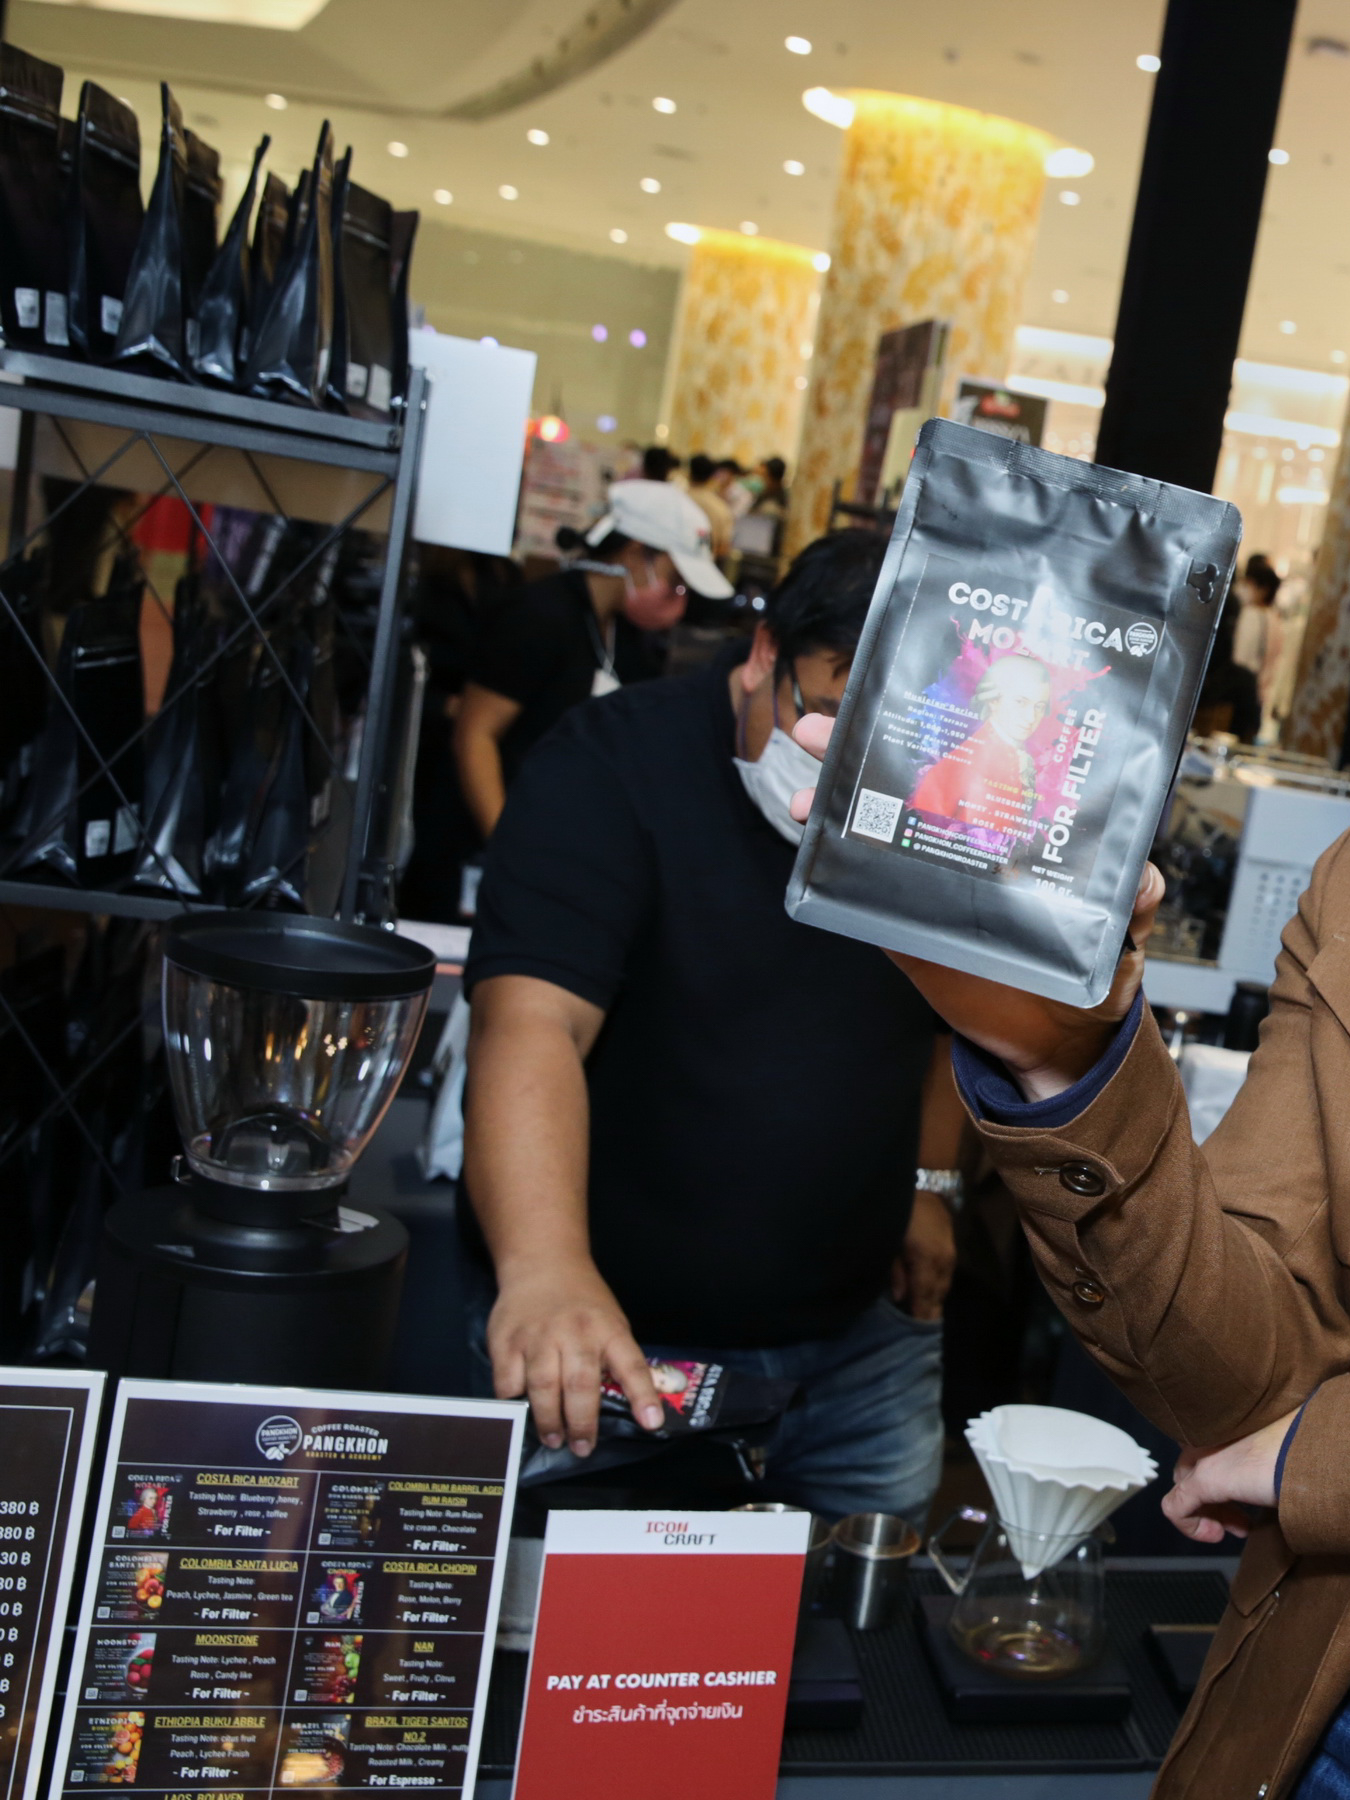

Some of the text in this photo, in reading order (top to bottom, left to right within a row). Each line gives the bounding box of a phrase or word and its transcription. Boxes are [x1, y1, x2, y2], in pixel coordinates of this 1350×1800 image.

[949, 582, 1048, 630] COST
[968, 618, 1090, 672] MOZRT
[903, 690, 980, 720] Musician Series
[882, 734, 905, 746] Plant
[1053, 708, 1078, 763] COFFEE
[1042, 708, 1107, 863] FOR FILTER
[985, 793, 1033, 812] BLUEBERRY
[993, 809, 1050, 831] STRAWBERRY
[1002, 825, 1035, 841] TOFFEE
[1031, 864, 1047, 875] NET
[1046, 869, 1075, 883] WEIGHT
[1035, 878, 1057, 891] 100
[310, 1423, 380, 1437] COFFEE ROASTER
[302, 1434, 389, 1454] PANGKHON
[196, 1473, 300, 1489] COSTA RICA MOZART
[388, 1481, 504, 1497] COLOMBIA RUM BARREL AGED
[189, 1491, 216, 1503] Tasting
[217, 1492, 237, 1502] Note:
[240, 1493, 275, 1505] Blueberry
[421, 1495, 468, 1508] RUM RAISIN
[198, 1506, 289, 1519] Strawberry rose toffee
[214, 1524, 264, 1538] For Filter
[441, 1524, 477, 1534] Chocolate
[413, 1539, 460, 1552] For Filter
[180, 1558, 299, 1572] COLOMBIA SANTA LUCIA
[383, 1561, 477, 1576] COSTA RICA CHOPIN
[208, 1575, 235, 1586] Tasting
[223, 1591, 252, 1601] Jasmine
[257, 1592, 280, 1601] Green
[280, 1593, 294, 1602] tea
[201, 1607, 251, 1620] For Filter
[402, 1611, 450, 1624] For Filter
[194, 1634, 260, 1647] MOONSTONE
[413, 1641, 435, 1654] NAN
[172, 1654, 199, 1665] Tasting
[220, 1656, 248, 1667] Lychee
[252, 1656, 277, 1665] Peach
[214, 1670, 239, 1681] Candy
[546, 1670, 778, 1691] PAY AT COUNTER CASHIER
[192, 1687, 242, 1700] For Filter
[391, 1690, 440, 1702] For Filter
[571, 1698, 744, 1727] ชำระสินค้าที่จุดจ่ายเงิน
[154, 1716, 267, 1729] ETHIOPIA BUKU ABBLE
[364, 1715, 469, 1729] BRAZIL TIGER SANTOS
[171, 1733, 199, 1745] Tasting
[170, 1749, 250, 1760] Peach Lychee Finish
[180, 1766, 231, 1779] For Filter
[369, 1774, 436, 1788] For Espresso
